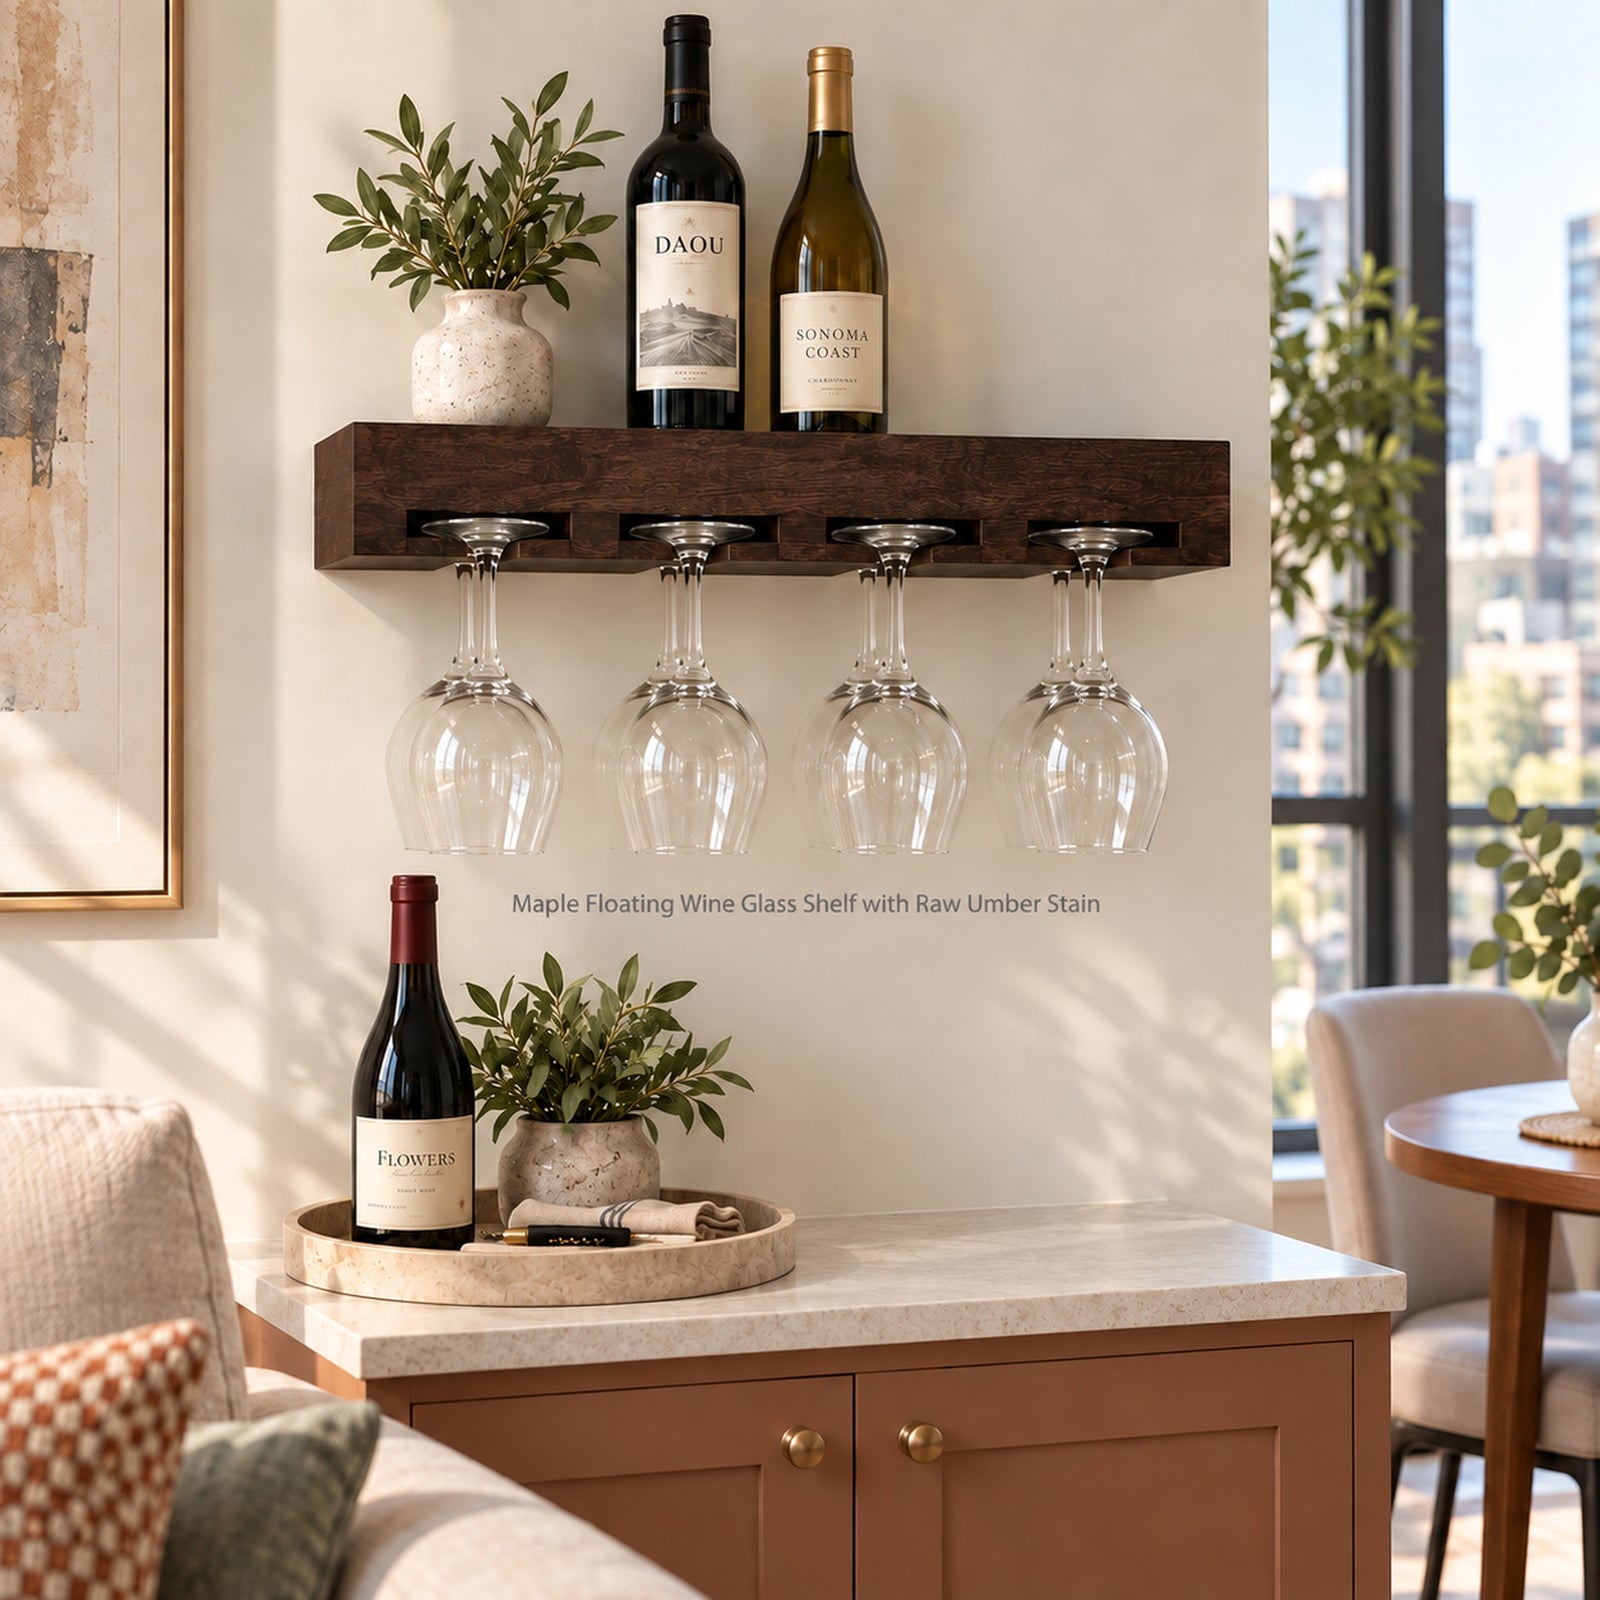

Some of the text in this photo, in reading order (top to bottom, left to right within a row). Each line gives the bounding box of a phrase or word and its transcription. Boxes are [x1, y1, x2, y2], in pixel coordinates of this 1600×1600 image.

[655, 235, 724, 255] DAOU
[796, 328, 869, 341] SONOMA
[805, 346, 861, 359] COAST
